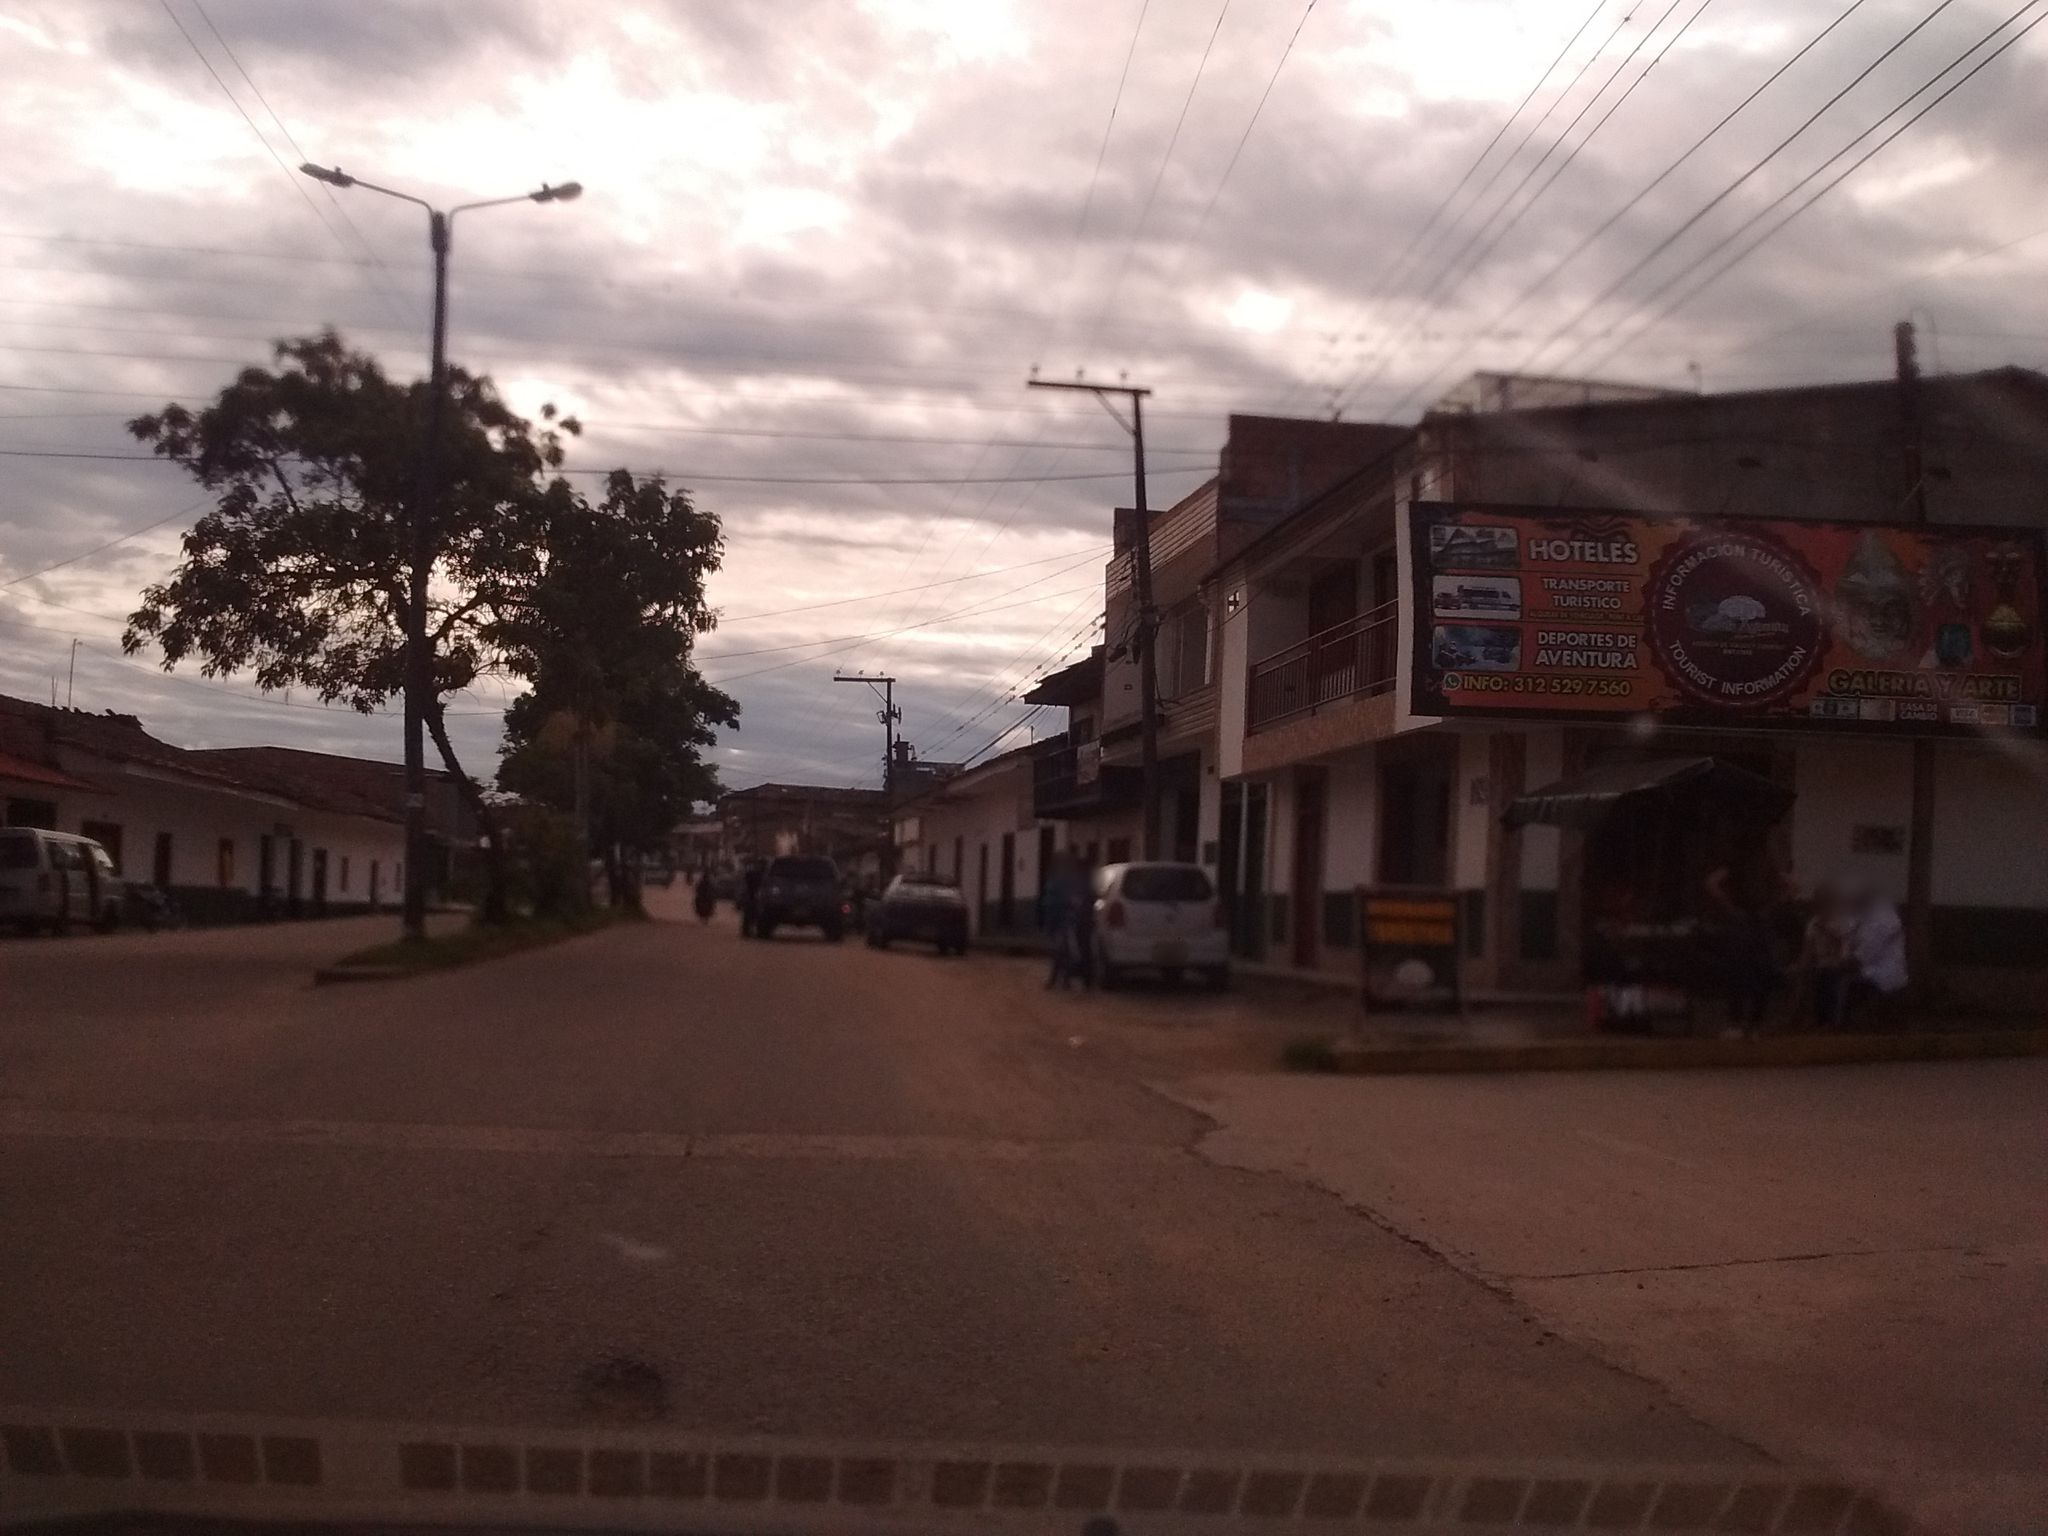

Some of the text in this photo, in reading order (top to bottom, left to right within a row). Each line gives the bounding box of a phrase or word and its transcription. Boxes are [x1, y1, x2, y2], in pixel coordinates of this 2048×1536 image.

[1529, 538, 1639, 564] HOTELES
[1543, 577, 1630, 593] TRANSPORTE
[1662, 544, 1811, 616] INFORMACION TURISTICA
[1553, 595, 1621, 609] TURISTICO
[1537, 631, 1637, 648] DEPORTES DE
[1536, 649, 1638, 669] AVENTURA
[1669, 640, 1807, 695] TOURIST INFORMATION
[1464, 676, 1632, 696] INFO: 312 529 7560
[1830, 670, 2021, 700] GALERIA Y ARTE
